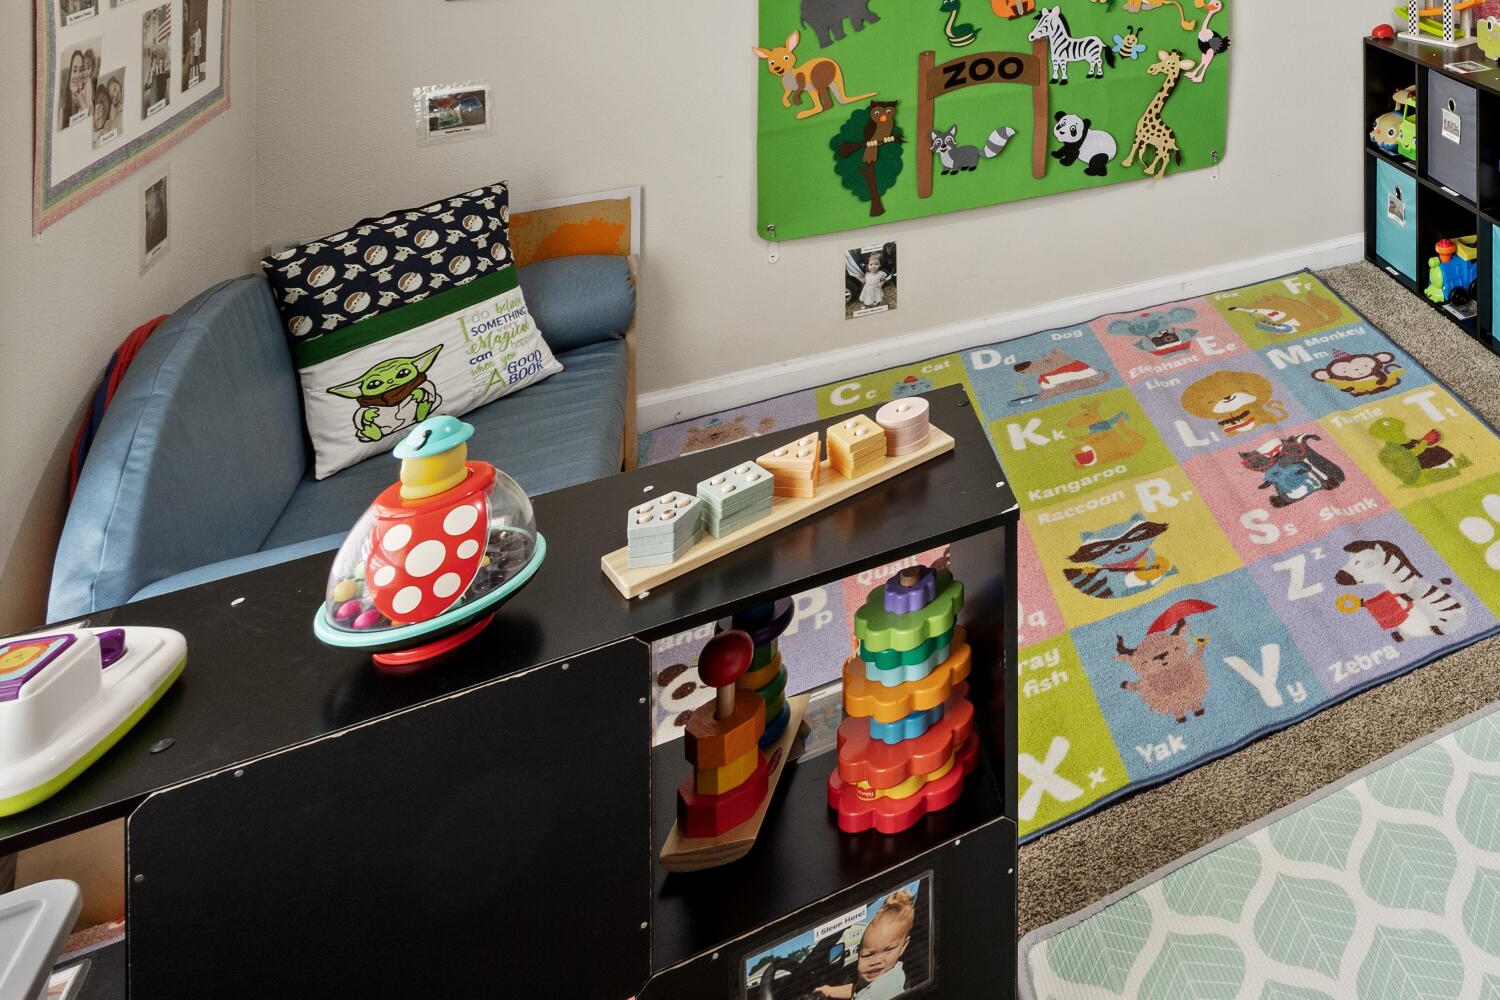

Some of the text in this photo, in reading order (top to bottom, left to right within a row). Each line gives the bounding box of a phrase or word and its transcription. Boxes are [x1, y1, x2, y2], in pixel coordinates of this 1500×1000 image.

[942, 57, 1025, 90] ZOO
[1214, 290, 1240, 301] Fox
[471, 306, 527, 337] SOMETHING
[1051, 328, 1083, 342] Dog
[467, 320, 529, 355] Magical
[1303, 325, 1366, 349] Monkey
[469, 350, 493, 366] can
[507, 349, 542, 375] GOOD
[921, 358, 951, 375] Cat
[1128, 353, 1199, 380] Elephant
[507, 360, 545, 386] BOOK
[1145, 374, 1181, 392] Lion
[1330, 405, 1384, 429] Turtle
[1028, 463, 1128, 502] Kangaroo
[1037, 489, 1126, 526] Raccoon
[1318, 496, 1379, 523] Skunk
[652, 621, 717, 653] and
[1017, 646, 1060, 677] ray
[1328, 645, 1402, 683] Zebra
[1022, 668, 1069, 699] fish
[1135, 733, 1189, 764] Yak
[820, 921, 843, 936] Sleep
[844, 909, 866, 924] Here!
